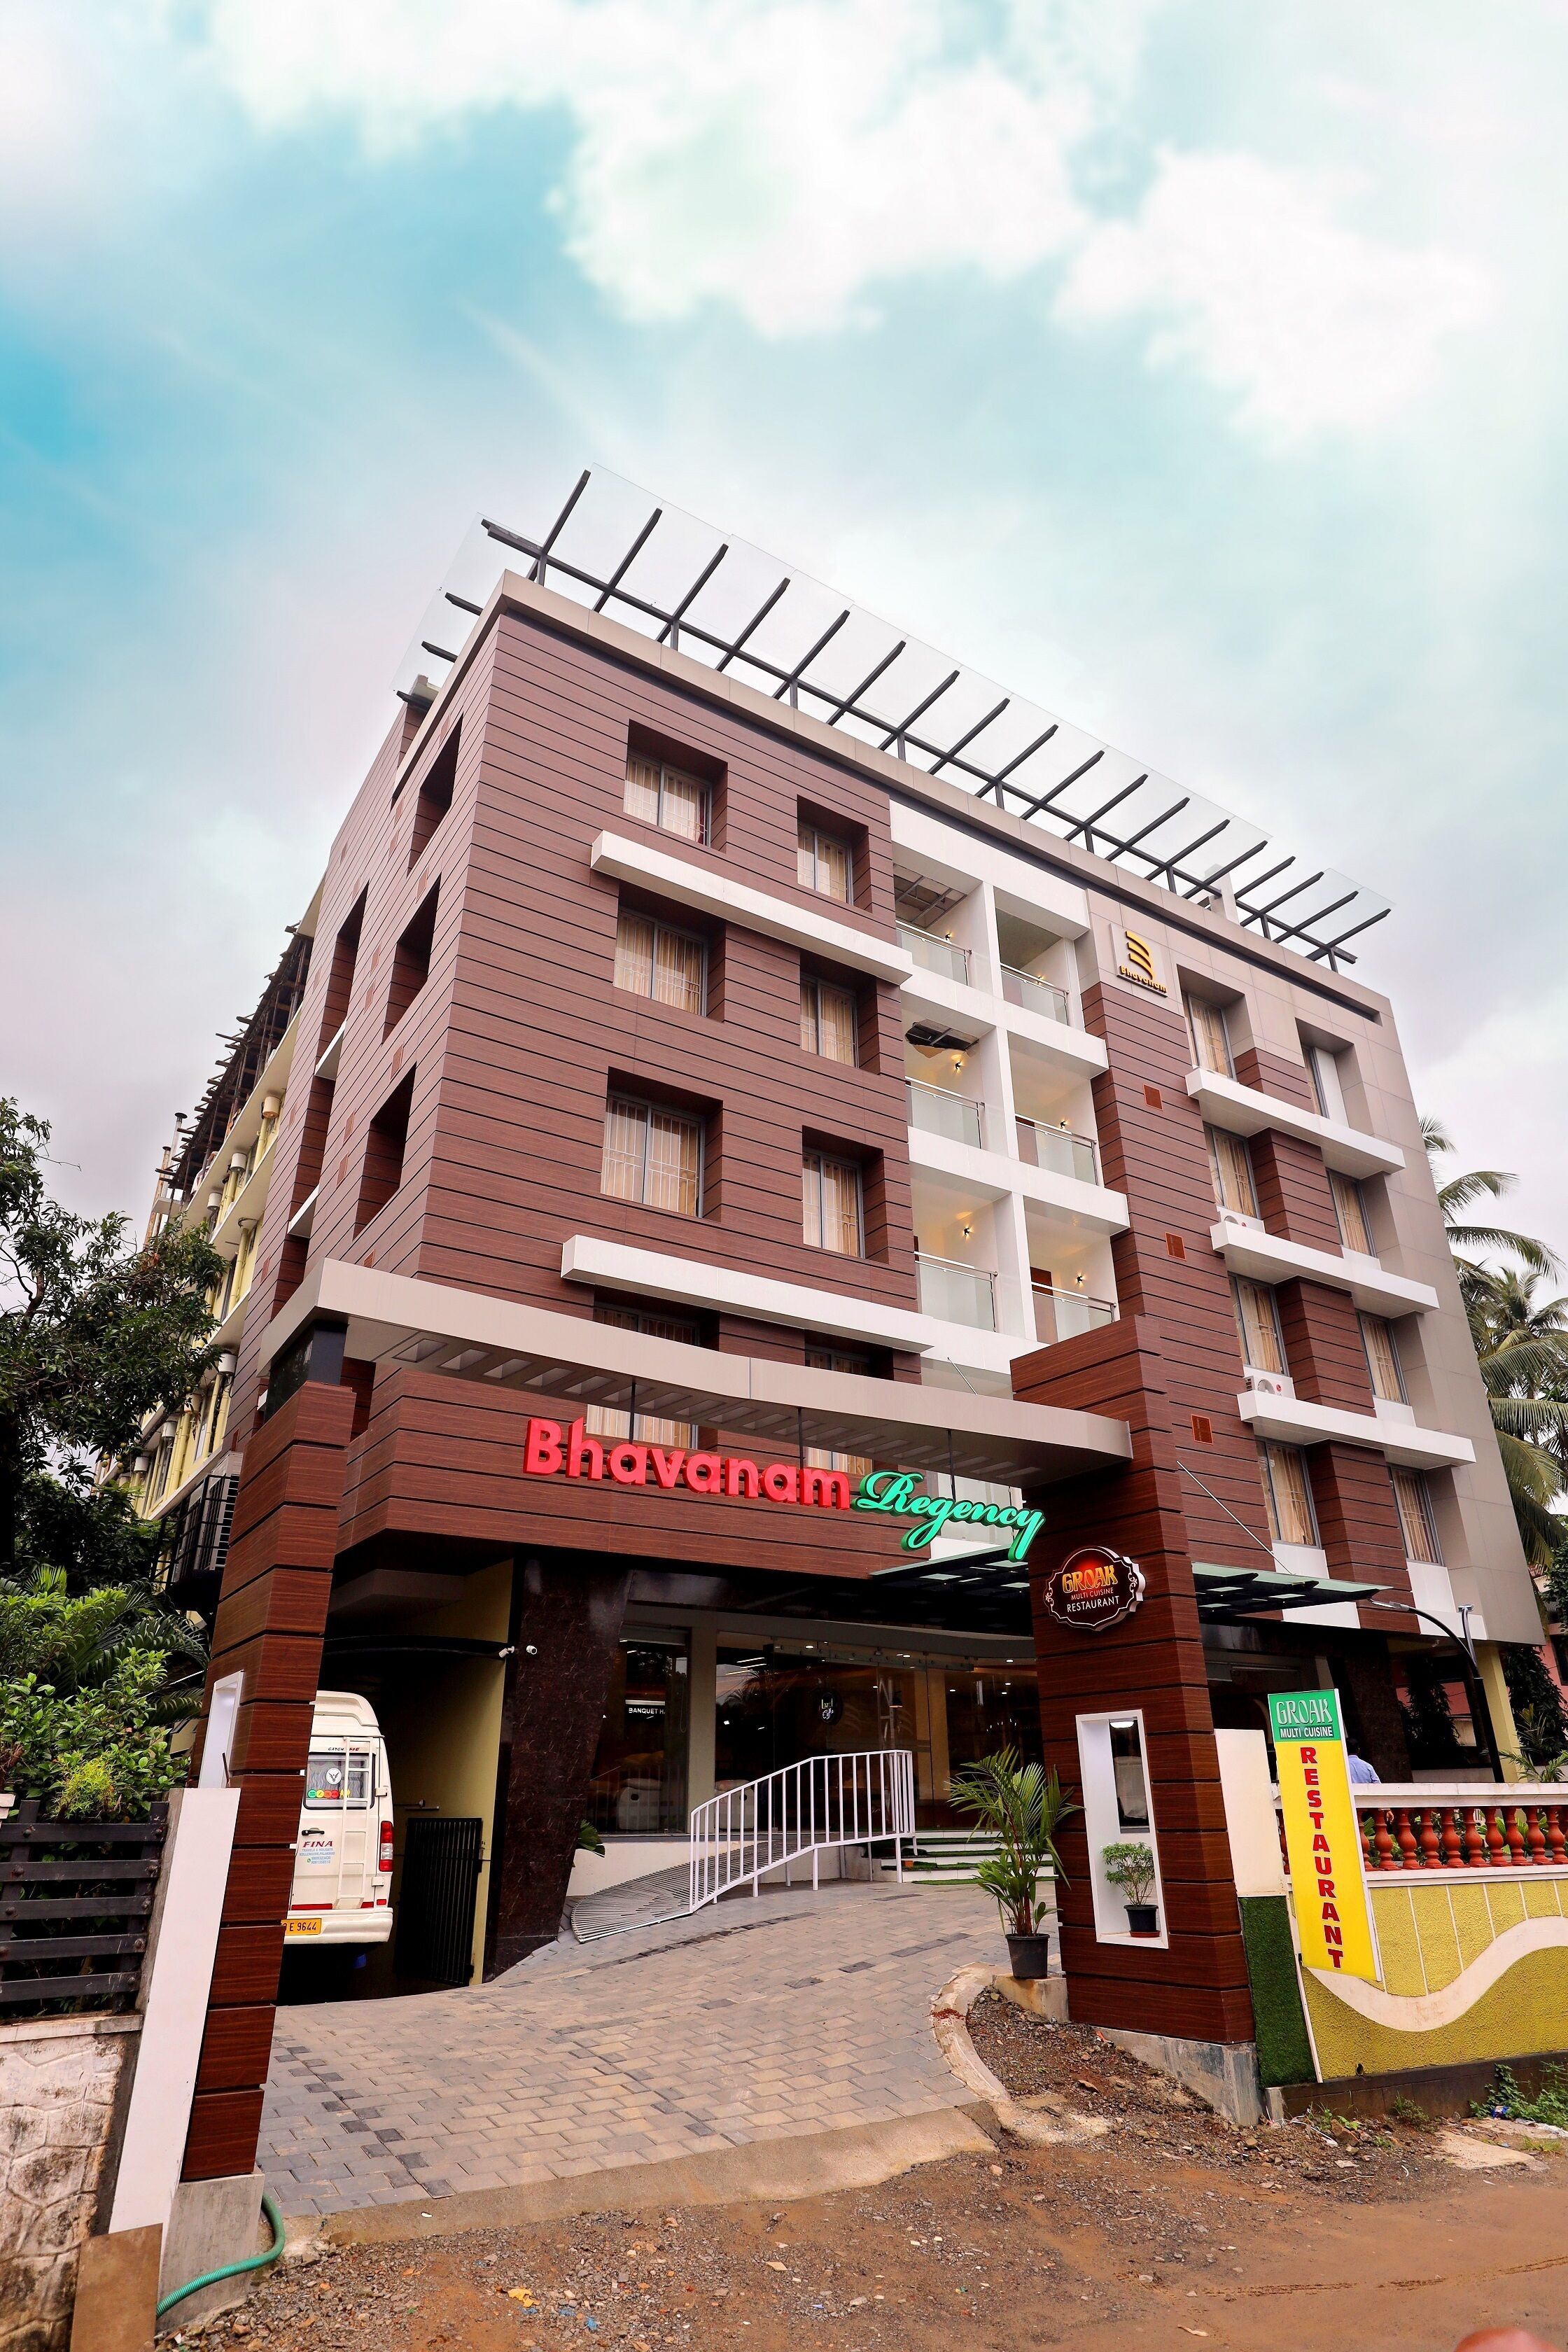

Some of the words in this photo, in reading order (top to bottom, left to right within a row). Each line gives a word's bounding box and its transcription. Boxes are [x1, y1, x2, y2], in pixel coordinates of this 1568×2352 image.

[1120, 965, 1167, 993] Bhavanam
[523, 1416, 850, 1510] Bhavanam
[851, 1469, 1046, 1562] Regency
[1062, 1565, 1118, 1593] GROAK
[1067, 1595, 1120, 1613] RESTAURANT
[1071, 1592, 1088, 1600] MULTI
[1089, 1588, 1114, 1598] CUISINE
[1276, 1698, 1333, 1725] GROAK
[1280, 1728, 1302, 1738] MULTI
[1304, 1726, 1334, 1737] CUISINE
[1300, 1746, 1344, 1969] RESTAURANT
[289, 1922, 294, 1932] E
[297, 1921, 317, 1931] 9644
